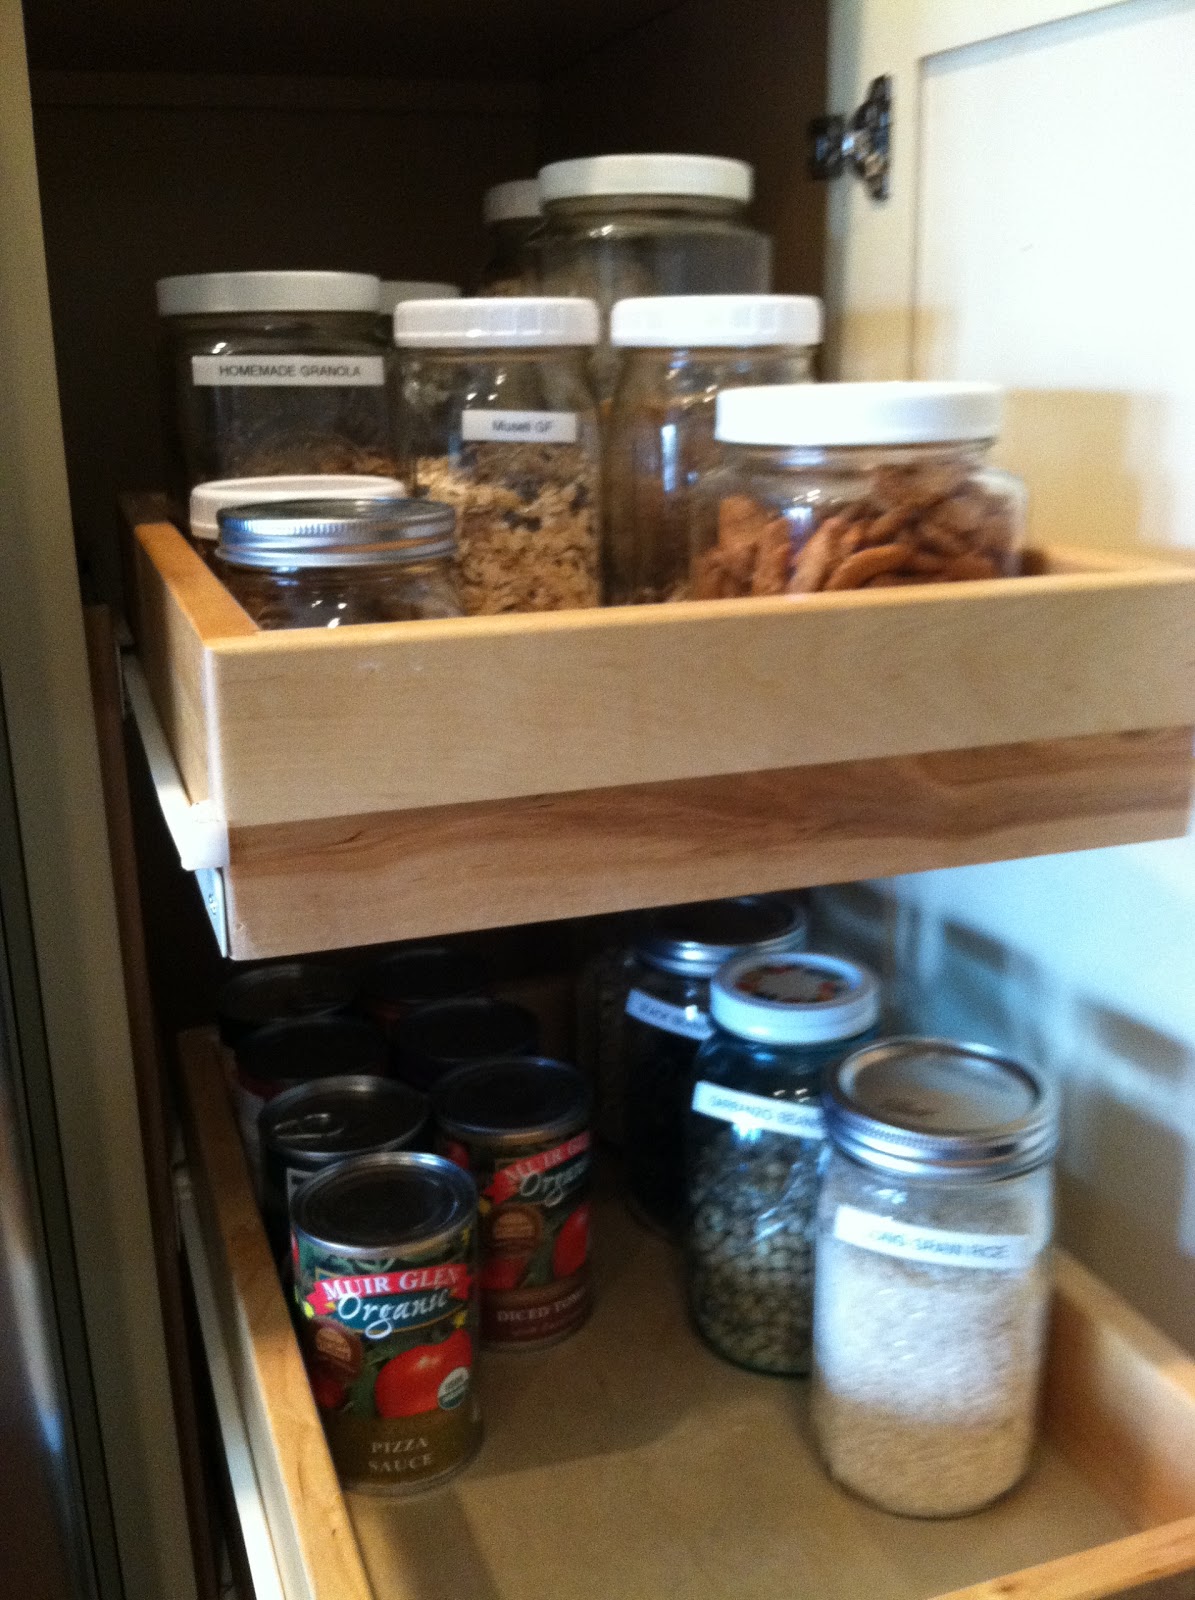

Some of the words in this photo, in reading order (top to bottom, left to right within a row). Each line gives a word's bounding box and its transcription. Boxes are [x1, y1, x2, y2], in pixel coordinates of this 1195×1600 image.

[219, 365, 296, 377] HOMEMADE
[300, 365, 361, 377] GRANOLA
[321, 1274, 392, 1301] MUIR
[399, 1265, 461, 1291] GLEN
[337, 1287, 449, 1340] Organic
[371, 1436, 430, 1454] PIZZA
[368, 1453, 434, 1473] SAUCE
